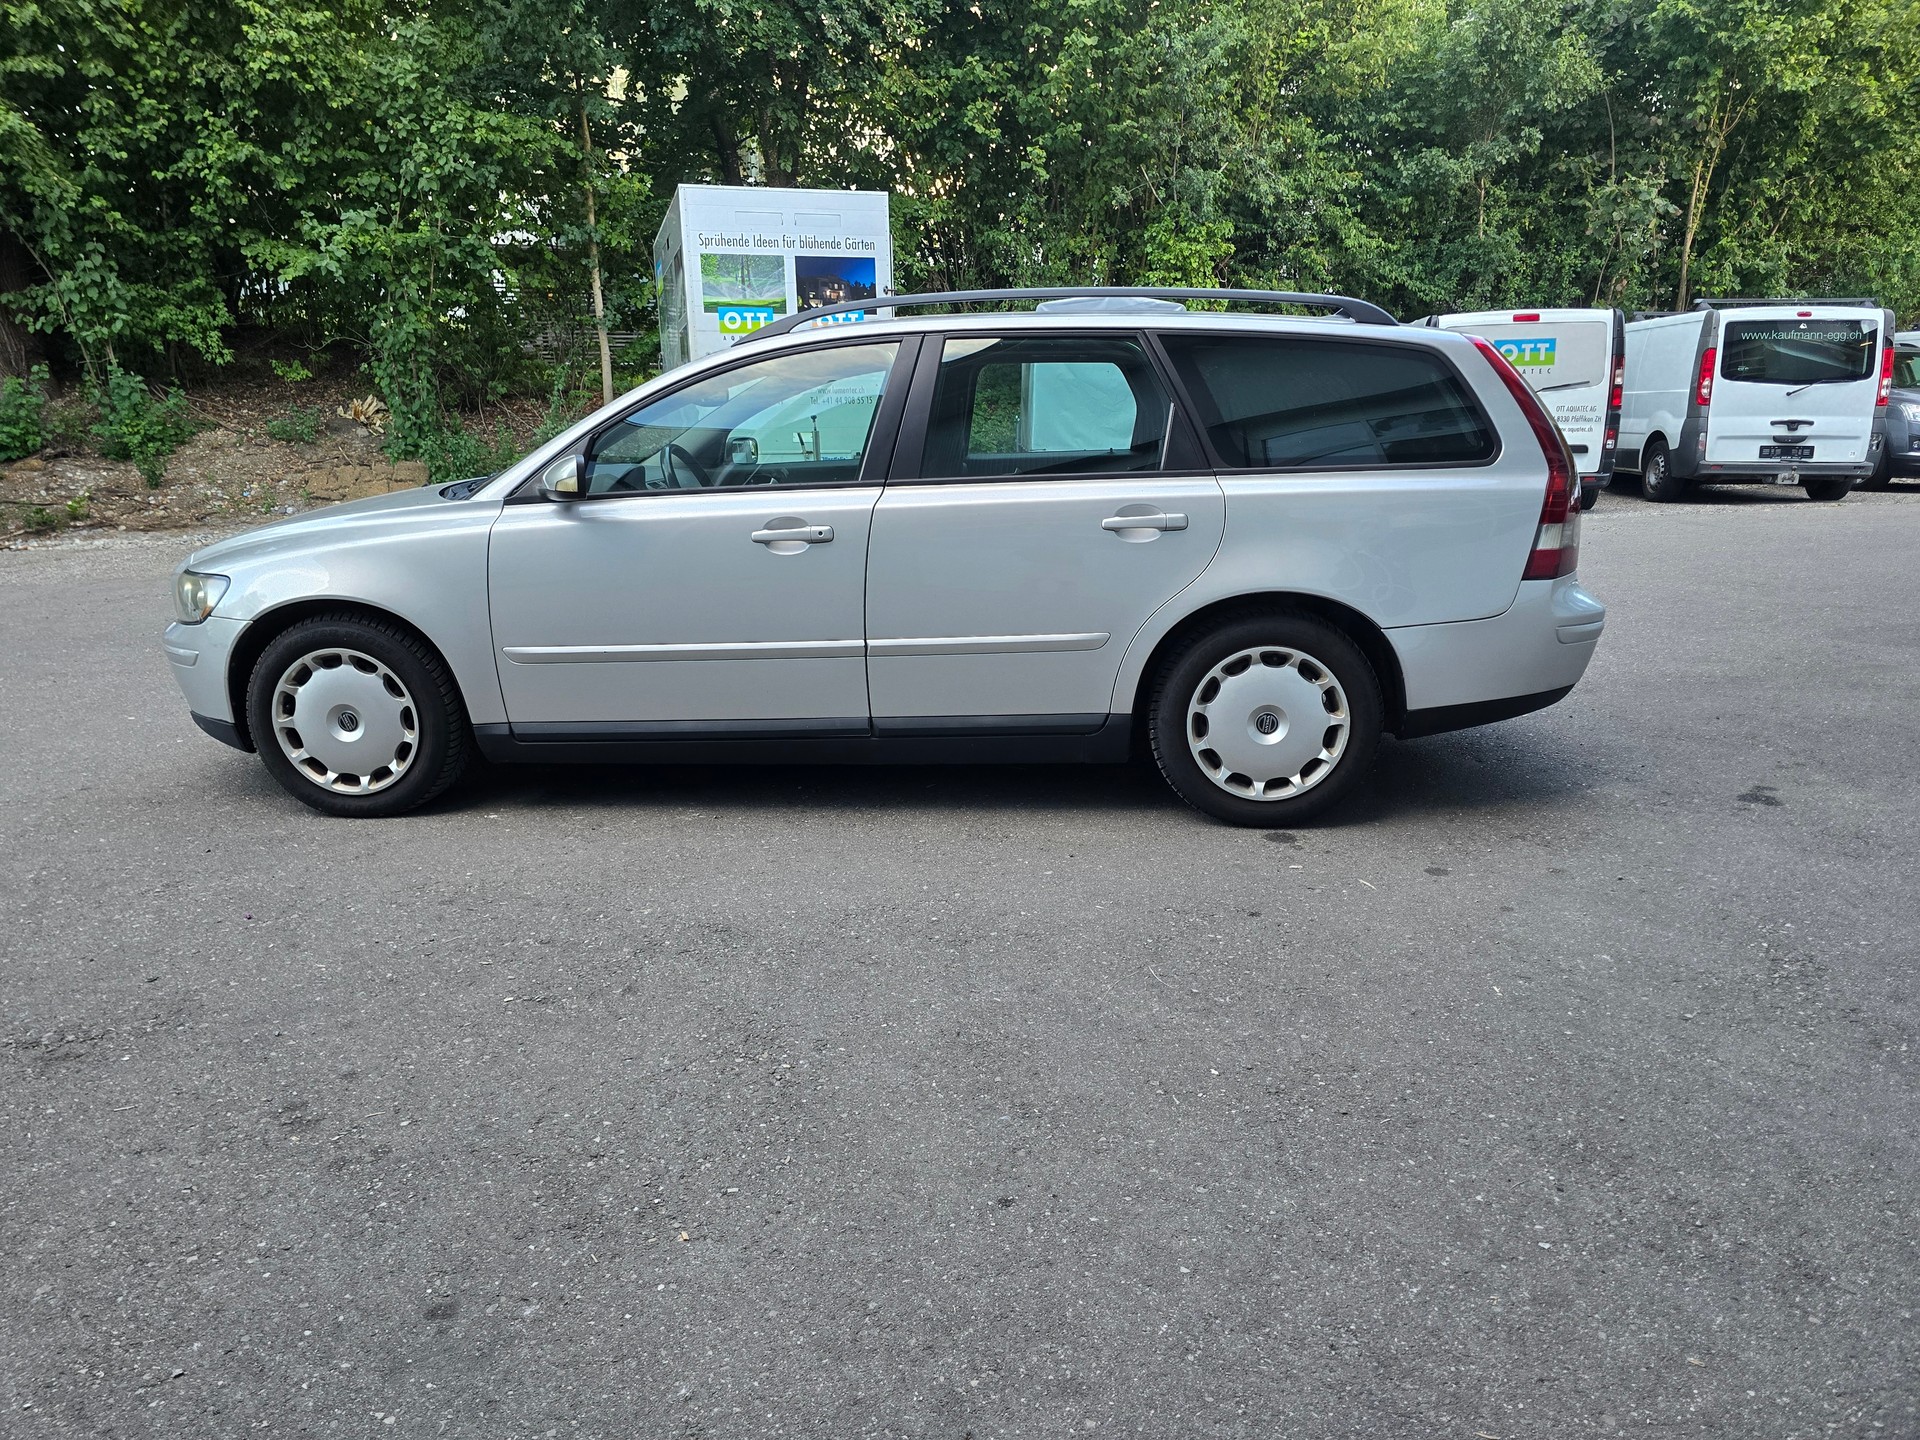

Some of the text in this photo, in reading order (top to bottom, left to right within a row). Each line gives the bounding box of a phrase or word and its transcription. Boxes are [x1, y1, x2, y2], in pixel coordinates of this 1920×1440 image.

[698, 232, 876, 251] Sprühende Ideen für blühende Gärten
[723, 311, 768, 330] OTT
[1741, 330, 1862, 342] www.kaufmann-egg.ch
[1499, 343, 1550, 362] OTT
[822, 396, 833, 405] +41
[835, 396, 843, 405] 44
[857, 396, 865, 405] 55
[866, 396, 873, 405] 15
